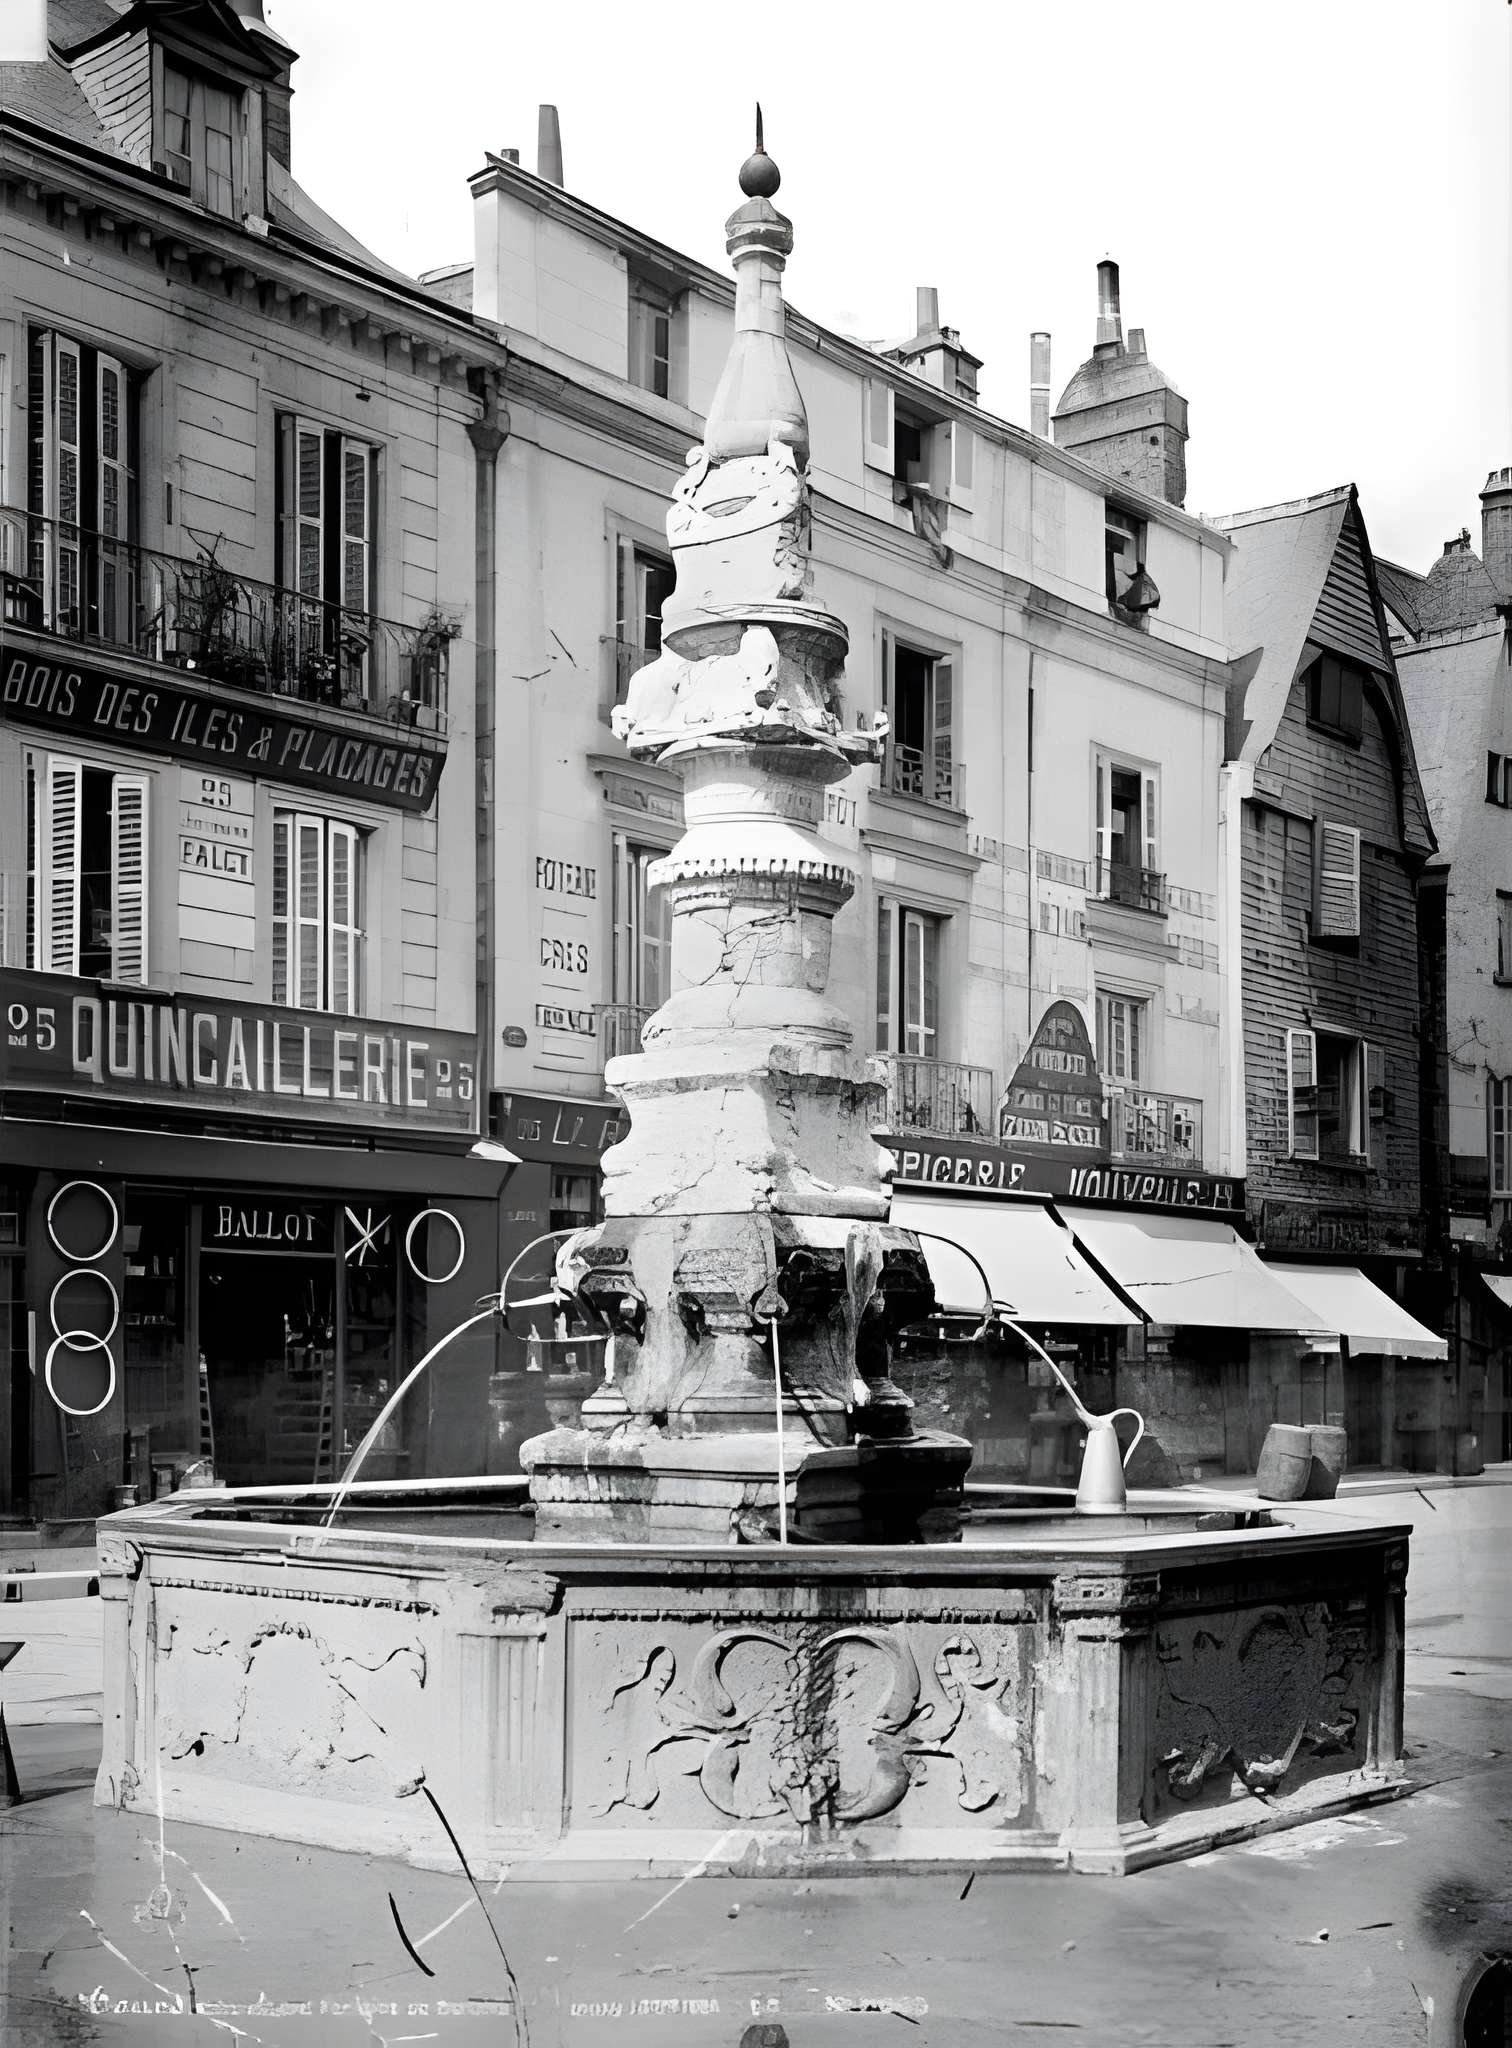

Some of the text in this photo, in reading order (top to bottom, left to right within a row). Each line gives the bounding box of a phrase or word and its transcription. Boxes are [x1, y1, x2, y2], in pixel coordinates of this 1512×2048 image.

[4, 659, 82, 716] BOIS
[93, 683, 159, 733] DES
[170, 700, 244, 753] ILES
[72, 996, 430, 1108] QUINCAILLERIE
